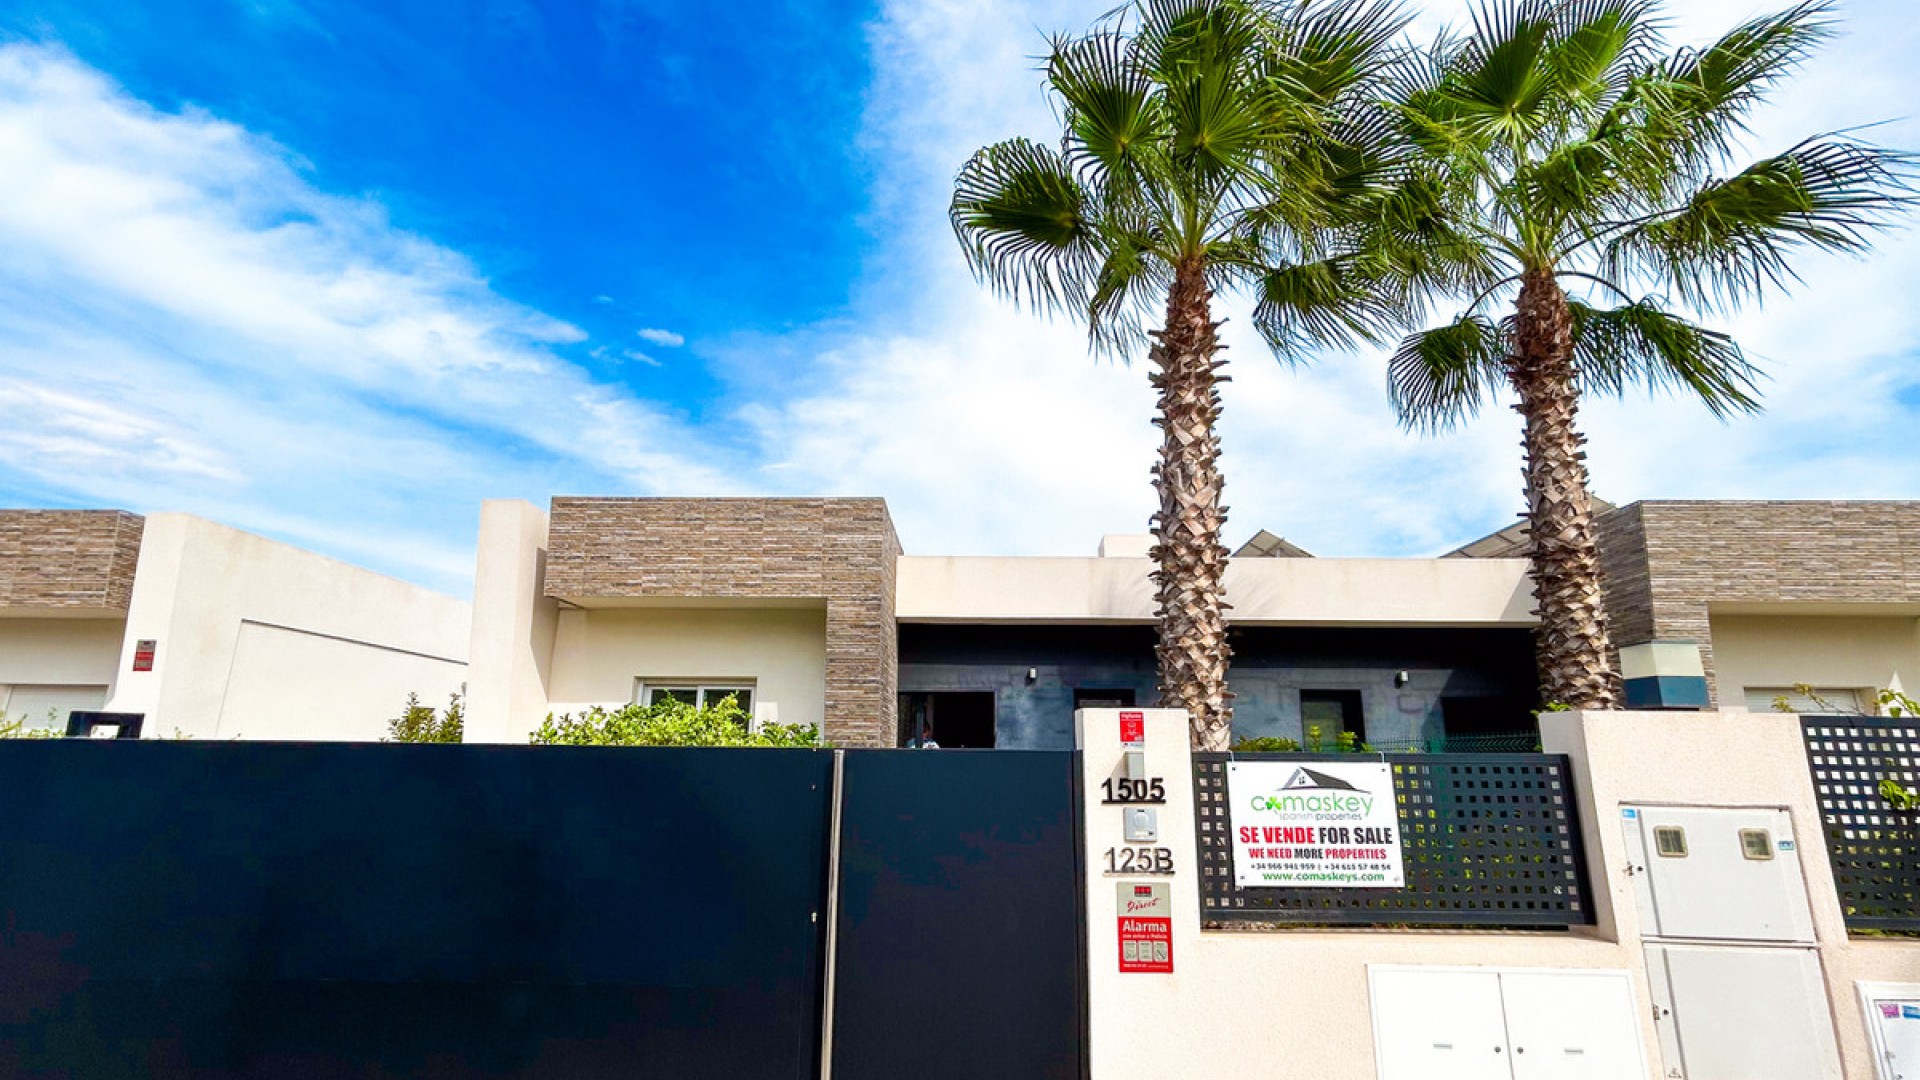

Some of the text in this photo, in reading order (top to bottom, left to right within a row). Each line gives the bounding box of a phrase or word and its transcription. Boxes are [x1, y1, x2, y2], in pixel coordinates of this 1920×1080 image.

[1101, 777, 1166, 802] 1505
[1280, 812, 1362, 821] spanish properties
[1240, 826, 1393, 845] SE VENDE FOR SALE
[1104, 847, 1174, 873] 125B
[1248, 848, 1387, 860] WE NEED MORE PROPERTIES
[1262, 872, 1385, 883] www.comaskeys.com
[1122, 919, 1167, 933] Alarma
